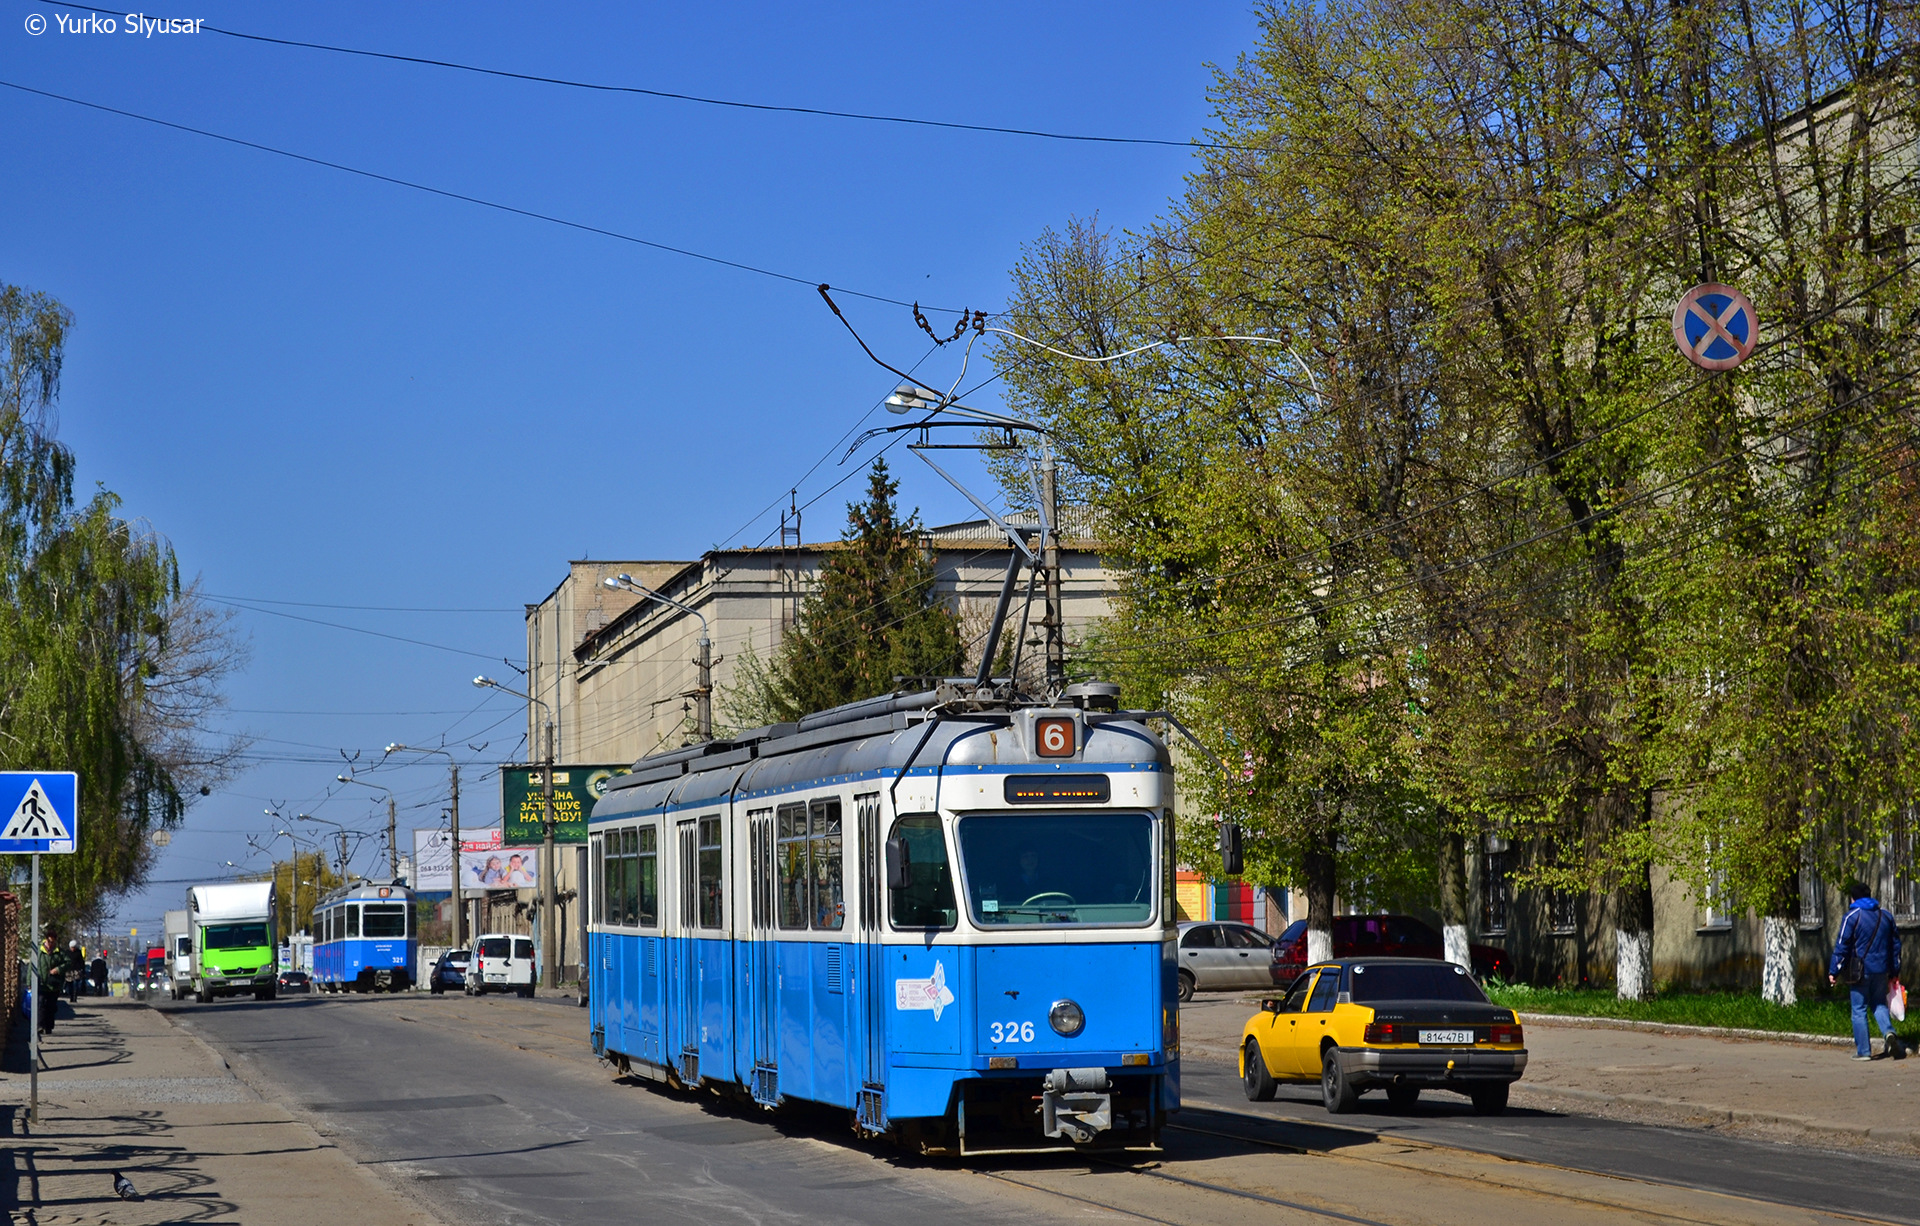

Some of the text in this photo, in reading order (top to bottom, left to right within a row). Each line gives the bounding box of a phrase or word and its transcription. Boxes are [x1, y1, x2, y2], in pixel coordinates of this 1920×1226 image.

[1044, 723, 1065, 751] 6
[527, 789, 573, 801] УКЇНА
[519, 812, 539, 823] НА
[990, 1021, 1035, 1043] 326
